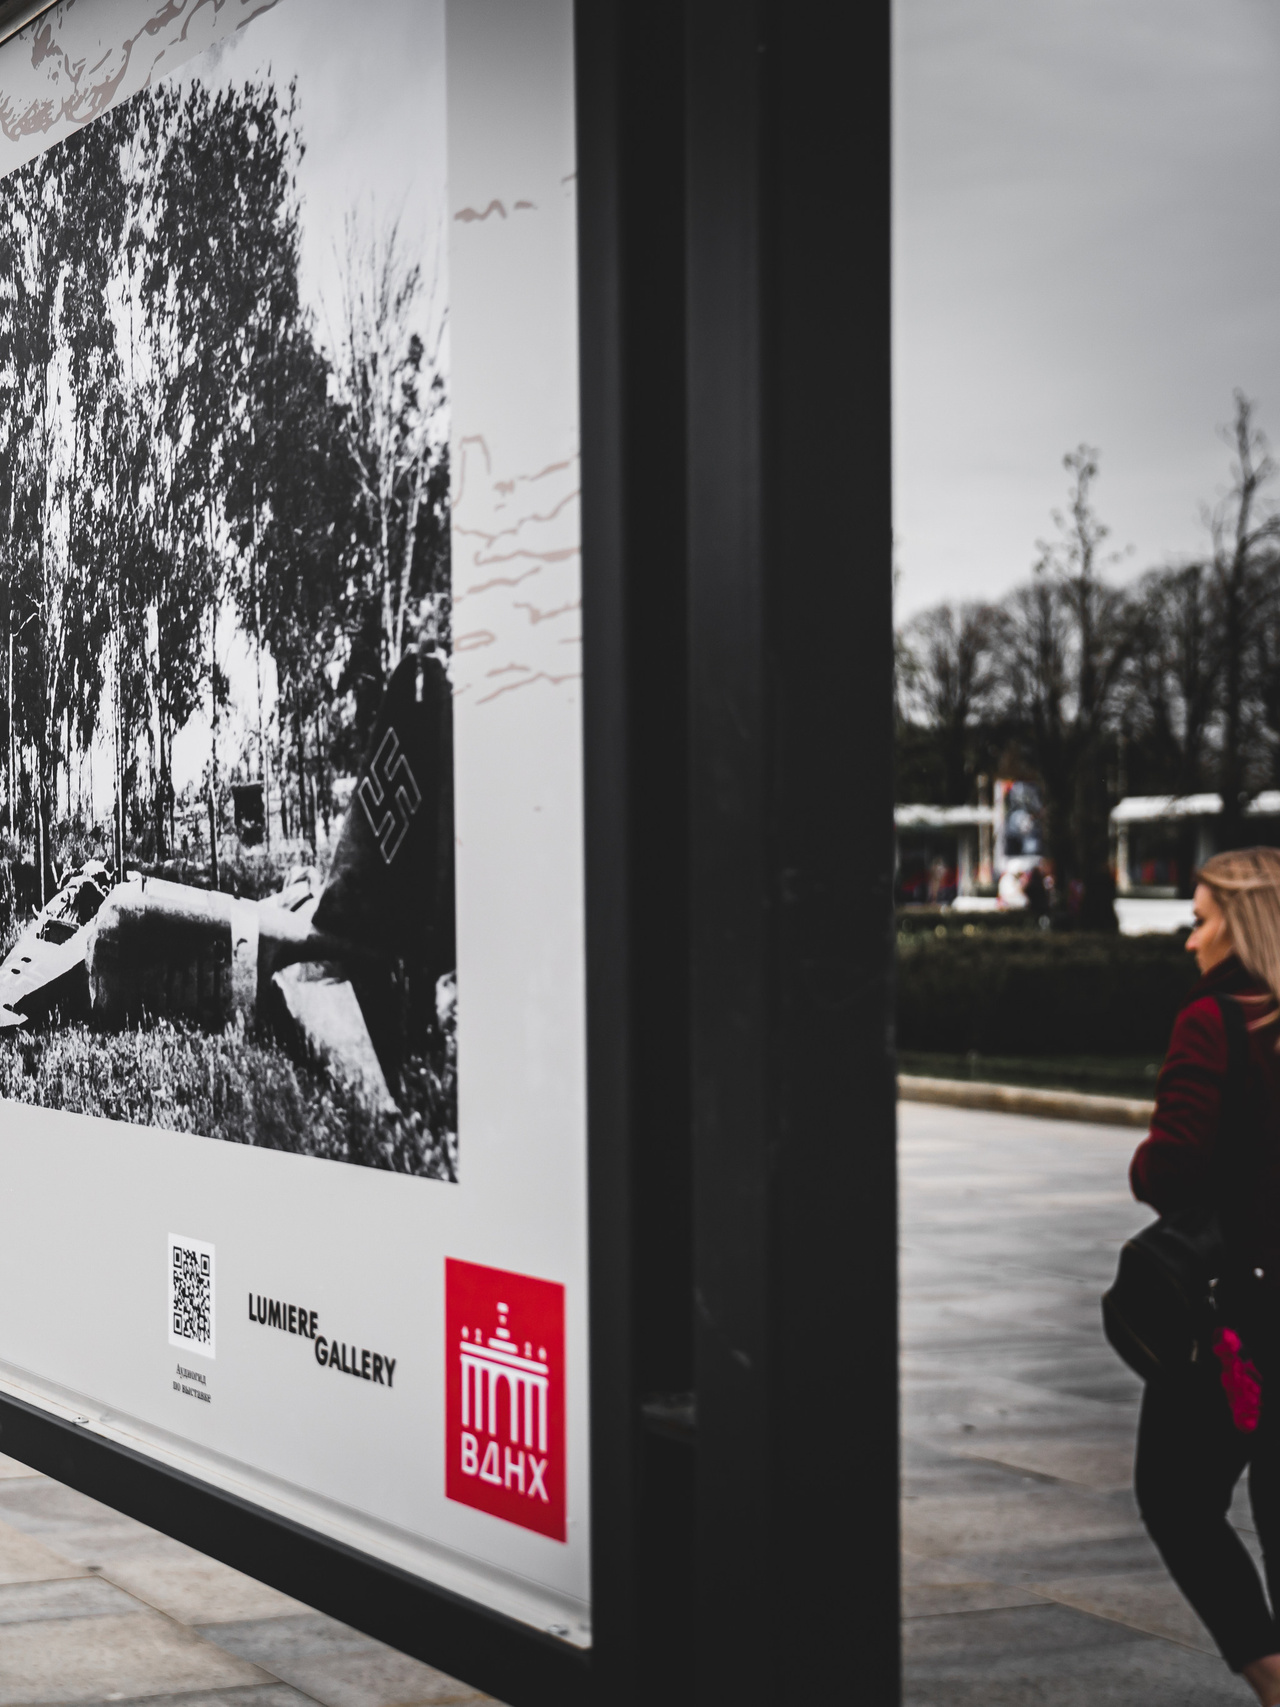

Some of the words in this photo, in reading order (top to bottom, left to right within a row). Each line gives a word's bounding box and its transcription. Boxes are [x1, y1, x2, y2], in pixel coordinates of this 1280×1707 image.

[248, 1292, 318, 1340] LUMIERE
[314, 1335, 397, 1388] GALLERY
[181, 1383, 211, 1404] выставке
[460, 1430, 550, 1502] ВДНХ
